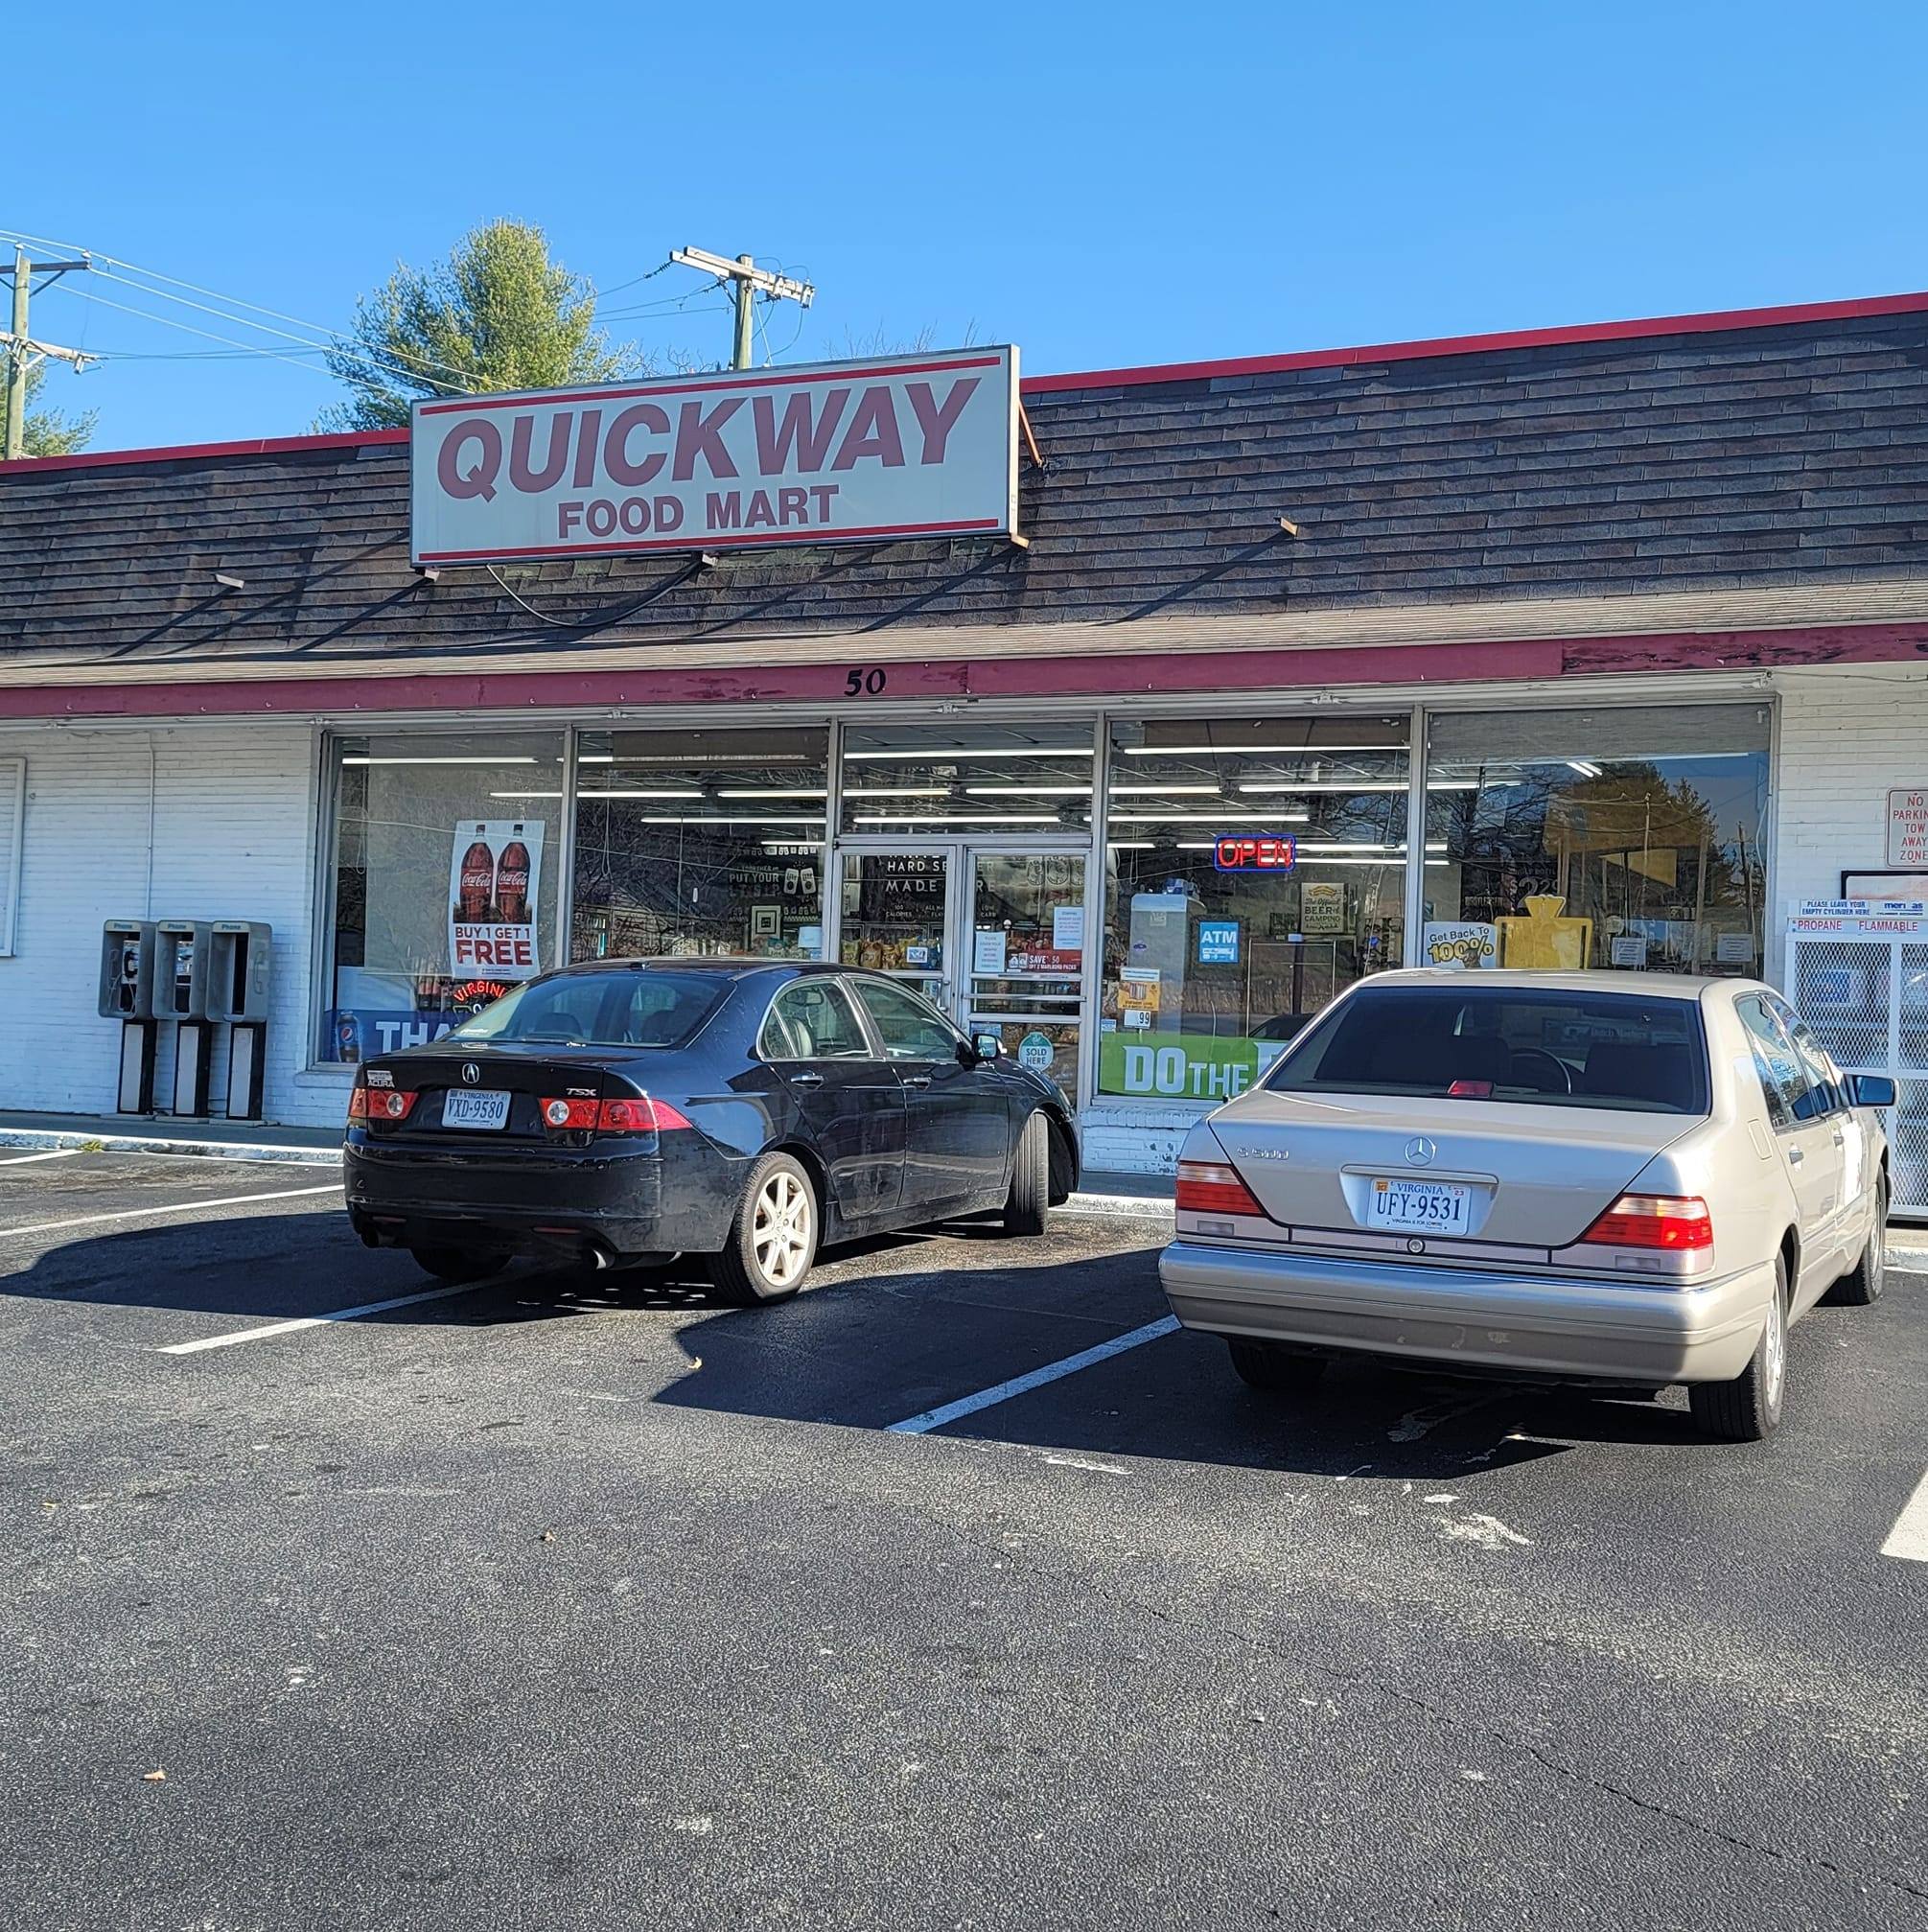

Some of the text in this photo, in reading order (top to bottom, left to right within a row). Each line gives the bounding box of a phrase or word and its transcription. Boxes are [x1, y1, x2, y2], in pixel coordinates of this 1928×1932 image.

[437, 378, 982, 502] QUICKWAY
[557, 484, 840, 539] FOOD MART
[844, 668, 887, 697] 50
[1907, 796, 1924, 806] NO
[1904, 824, 1926, 833] TOW
[1901, 837, 1928, 847] AWAY
[1219, 839, 1291, 867] OPEN
[1900, 850, 1928, 860] ZONE
[887, 861, 924, 872] HARD
[729, 873, 749, 882] PUT
[753, 873, 779, 882] YOUR
[886, 880, 937, 892] MADE
[1798, 919, 1843, 930] PROPANE
[1858, 920, 1918, 932] FLAMMABLE
[455, 927, 530, 939] BUY 1 GET 1
[1201, 930, 1237, 943] ATM
[1429, 926, 1490, 943] Get Back To
[455, 940, 533, 966] FREE
[1428, 936, 1495, 964] 100%
[453, 981, 507, 1003] VIRGINI
[1026, 1048, 1047, 1057] SOLD
[1026, 1057, 1046, 1065] HERE
[1123, 1045, 1250, 1096] DO THE
[367, 1080, 396, 1088] ACURA
[566, 1087, 596, 1096] TSX
[448, 1098, 504, 1119] VXD-9580
[1397, 1183, 1443, 1196] VIRGINIA
[1377, 1193, 1461, 1221] UFY-9531
